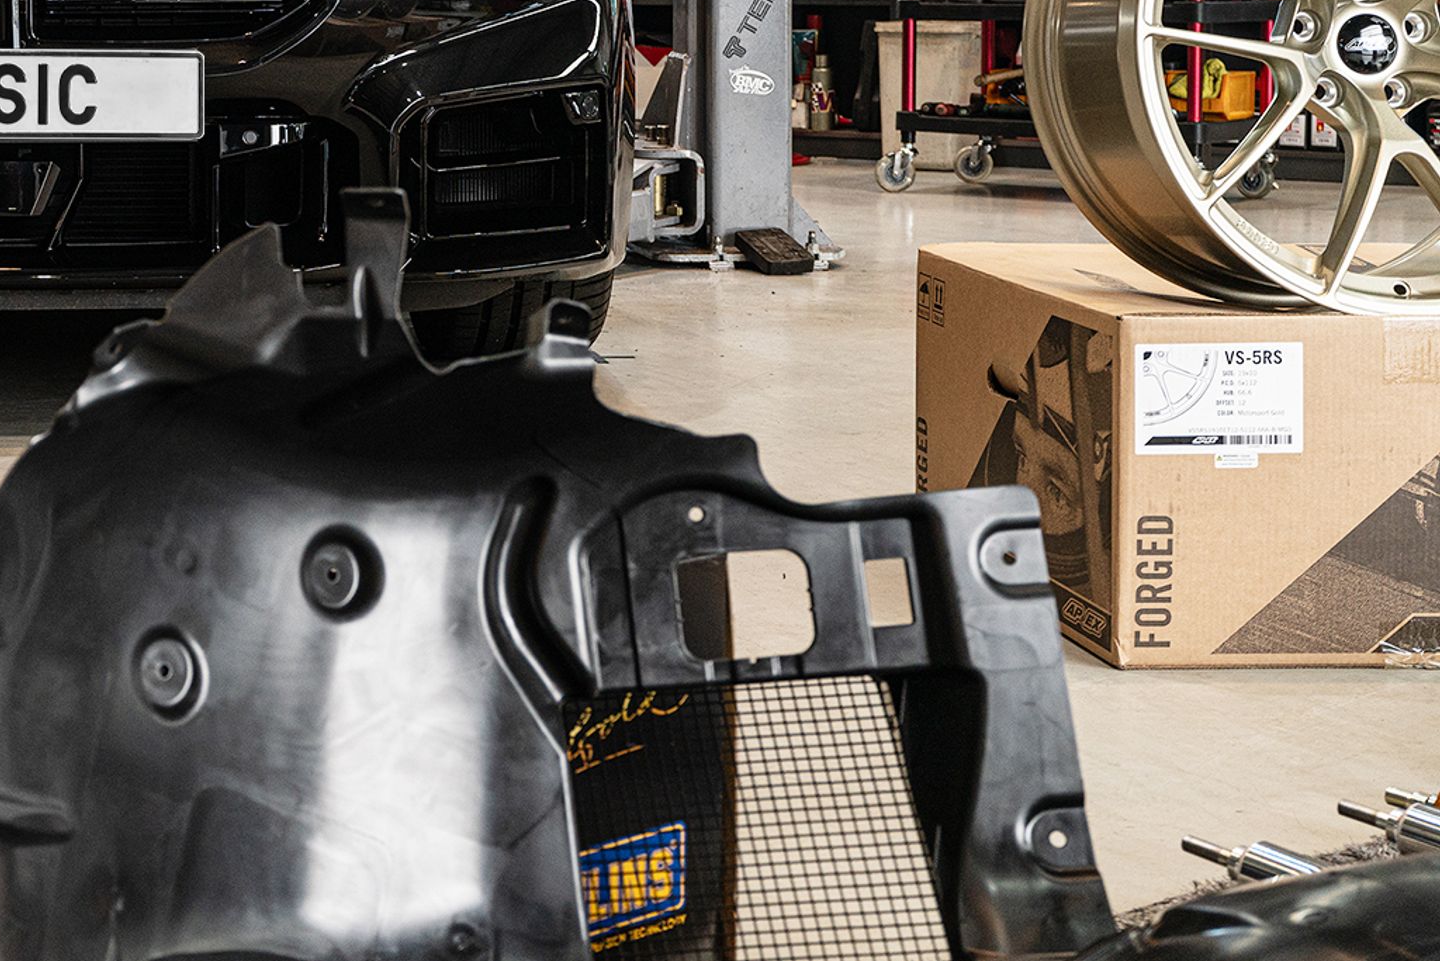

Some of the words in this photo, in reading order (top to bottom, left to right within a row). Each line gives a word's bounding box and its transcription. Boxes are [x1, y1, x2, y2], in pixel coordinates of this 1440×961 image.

[735, 75, 771, 92] BMC
[1225, 349, 1283, 365] VS-5RS
[916, 416, 928, 493] RGED
[1134, 515, 1174, 648] FORGED
[581, 847, 674, 923] LINS
